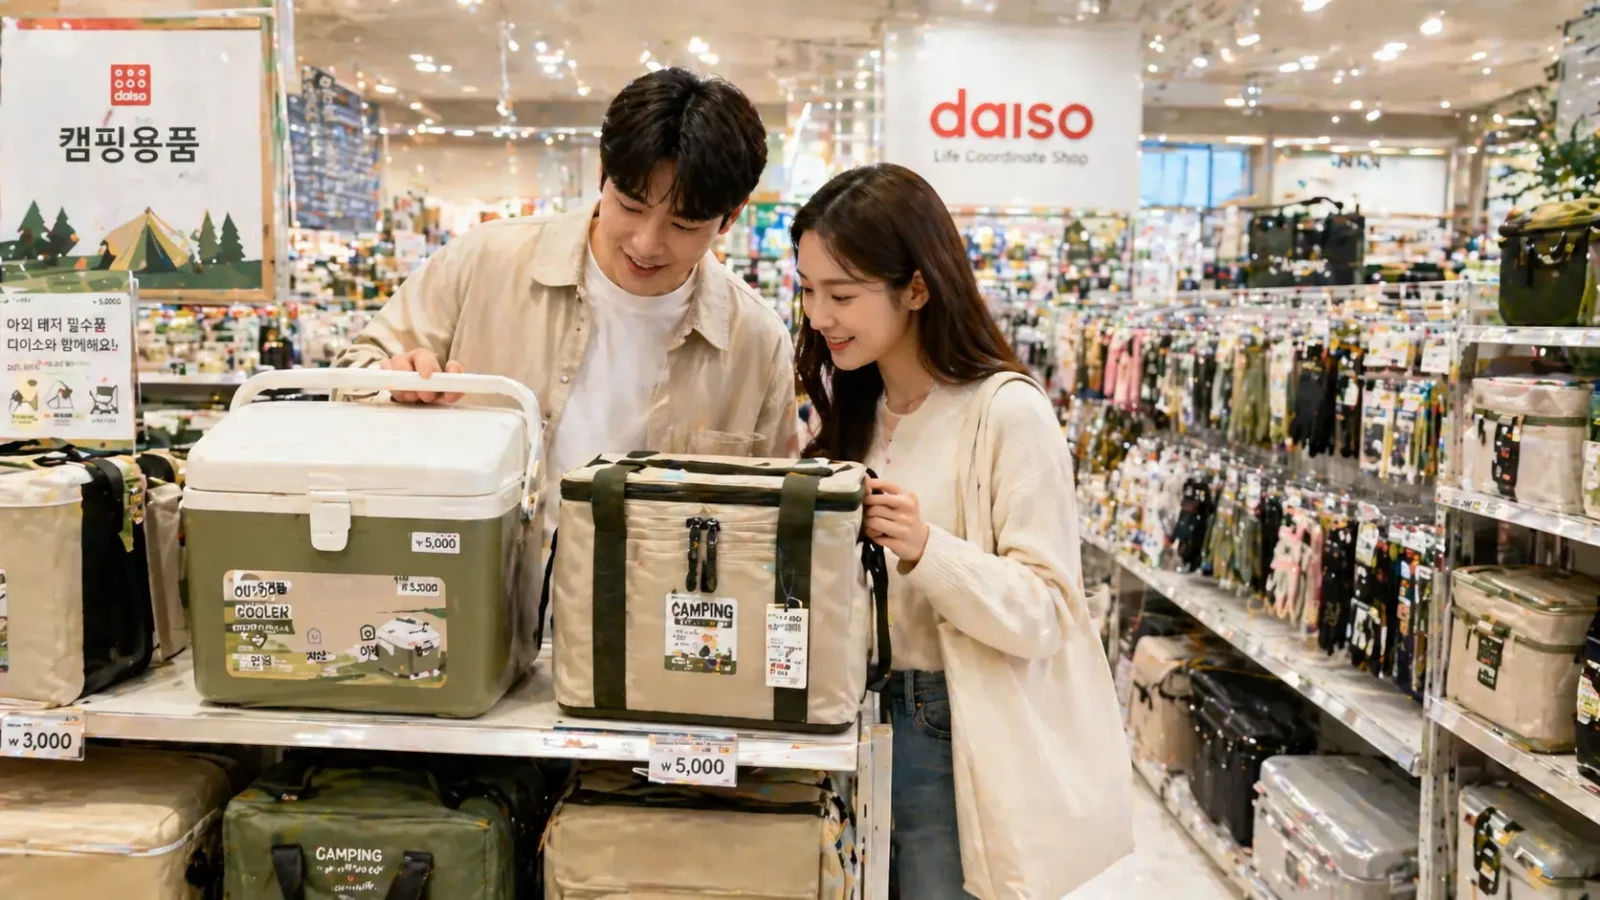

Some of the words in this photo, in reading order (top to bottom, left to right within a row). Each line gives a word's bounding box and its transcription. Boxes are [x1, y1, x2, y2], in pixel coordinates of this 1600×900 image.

[114, 90, 147, 102] daiso
[930, 88, 1093, 140] daiso
[59, 126, 199, 163] 캠핑용품
[934, 150, 960, 163] Life
[965, 150, 1046, 164] Coordinate
[1052, 151, 1089, 166] Shop
[425, 537, 456, 549] 5,000
[237, 605, 290, 618] COOLER
[671, 602, 733, 619] CAMPING
[23, 731, 72, 751] 3,000
[676, 757, 724, 776] 5,000
[315, 846, 383, 862] CAMPING
